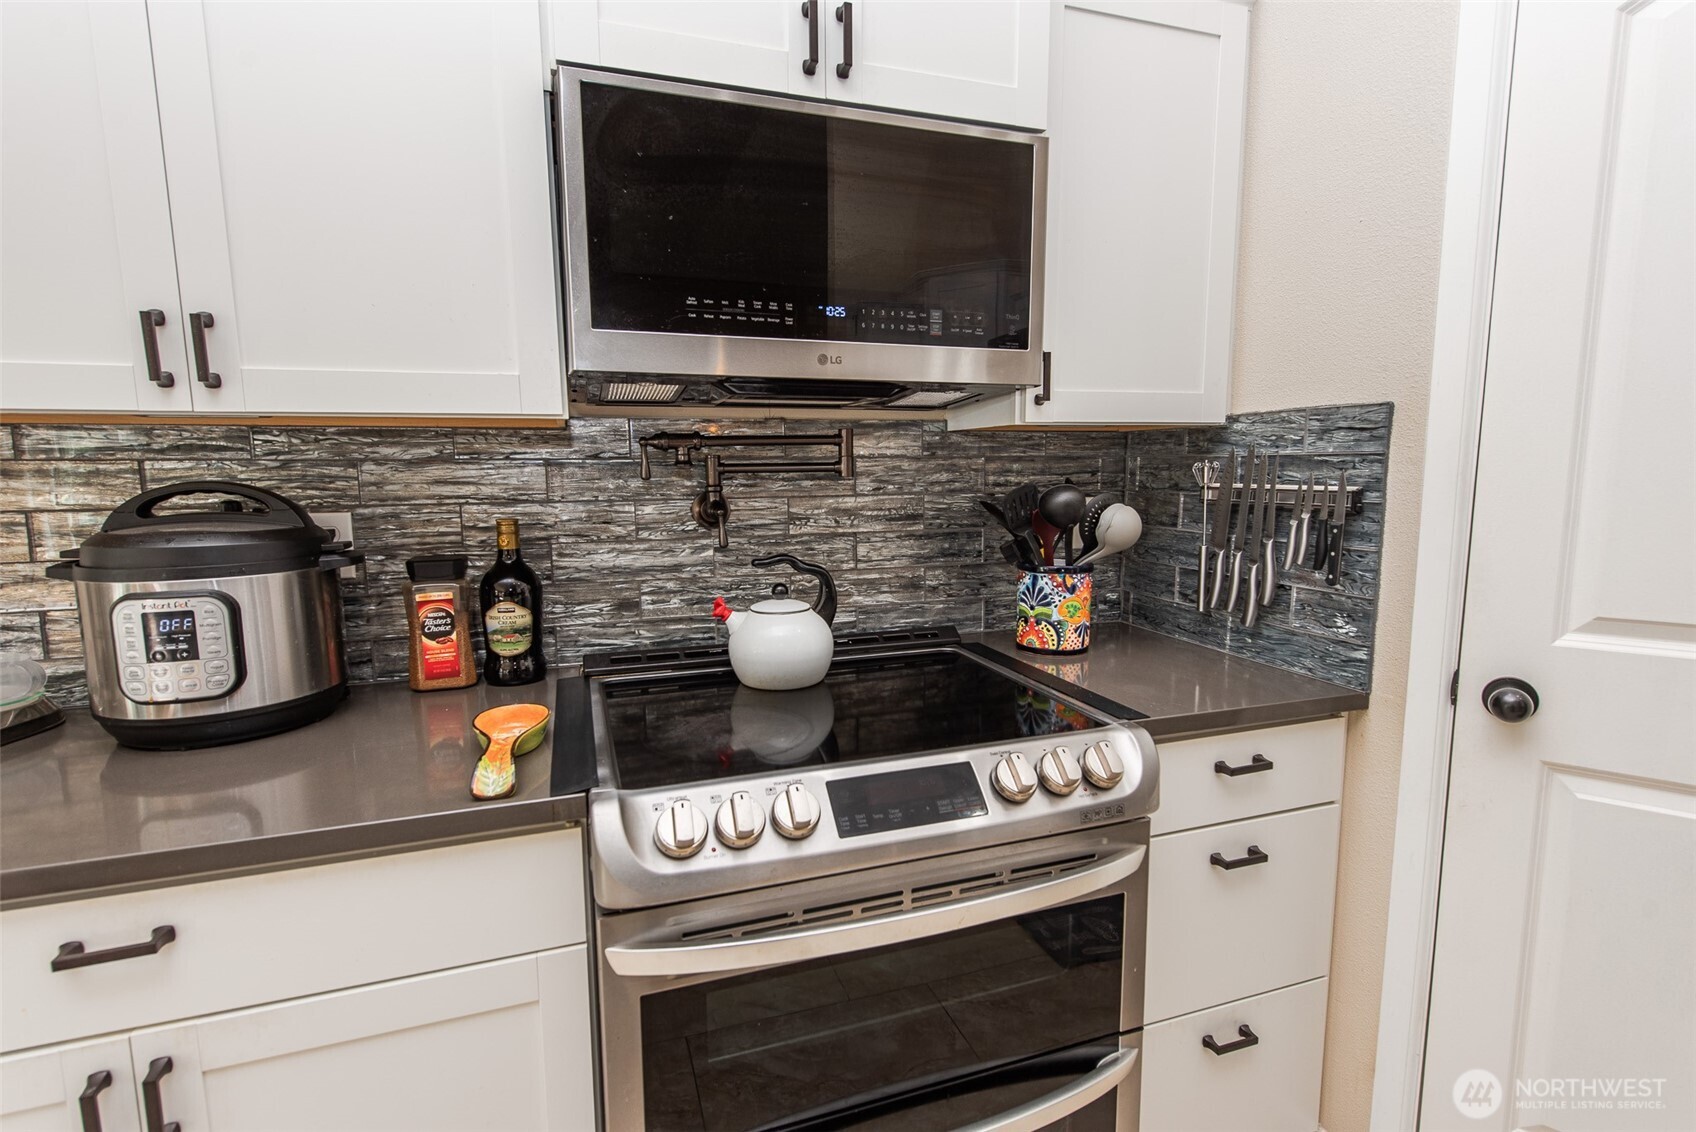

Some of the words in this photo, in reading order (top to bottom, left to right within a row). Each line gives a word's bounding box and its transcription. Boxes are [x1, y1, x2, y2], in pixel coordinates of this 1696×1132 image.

[830, 355, 842, 365] LG
[159, 618, 192, 632] OFF
[423, 617, 452, 625] Taster's
[425, 624, 452, 633] Choice
